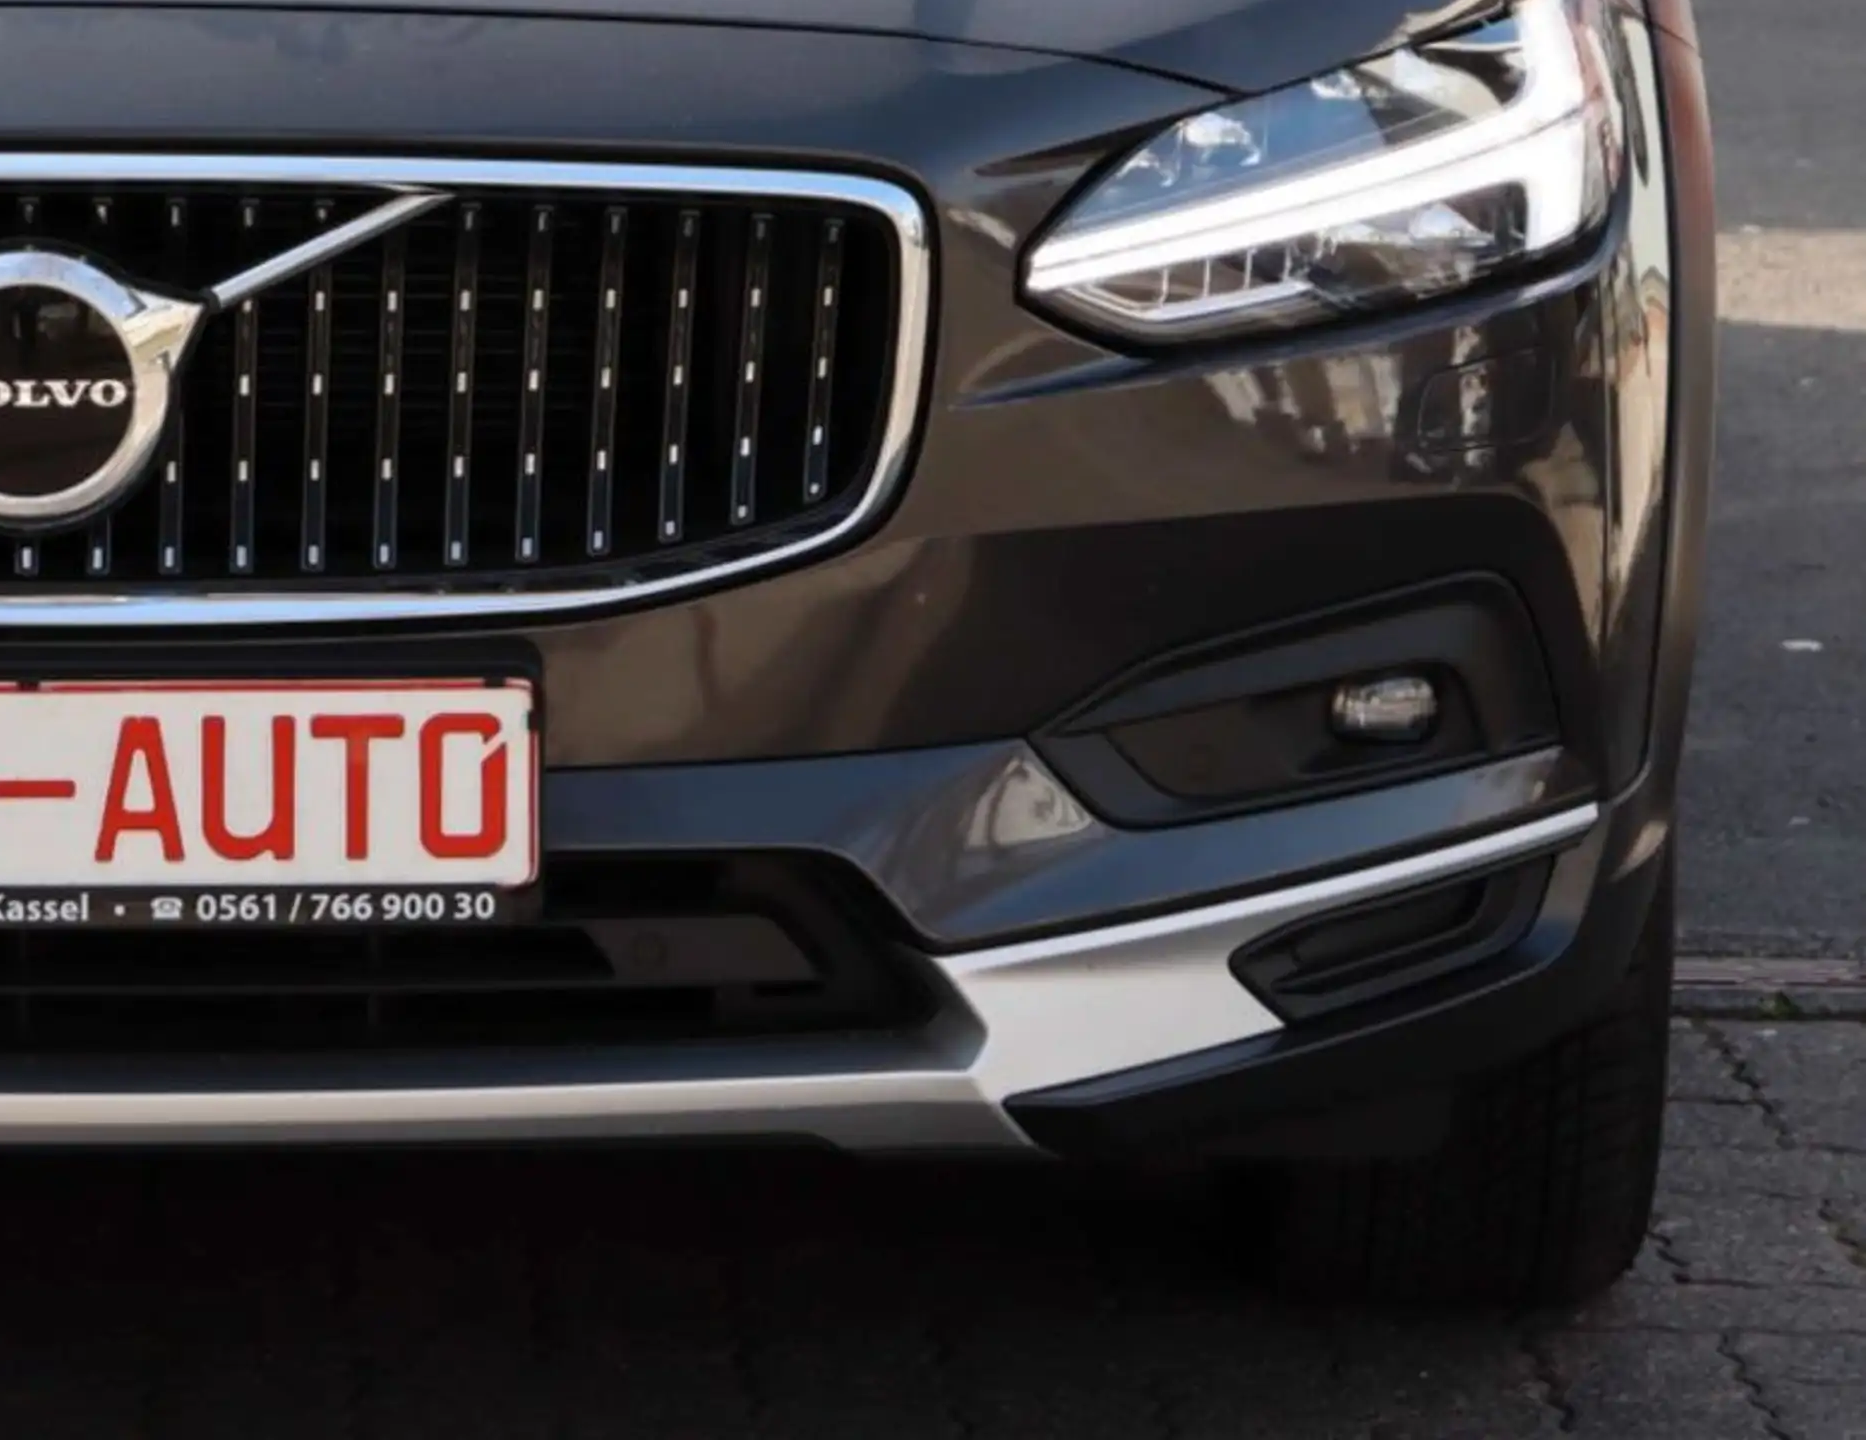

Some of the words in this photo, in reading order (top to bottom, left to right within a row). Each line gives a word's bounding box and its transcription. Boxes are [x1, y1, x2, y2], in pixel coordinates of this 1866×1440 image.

[195, 892, 278, 923] 0561
[310, 892, 375, 922] 766
[380, 891, 446, 921] 900
[452, 890, 497, 921] 30
